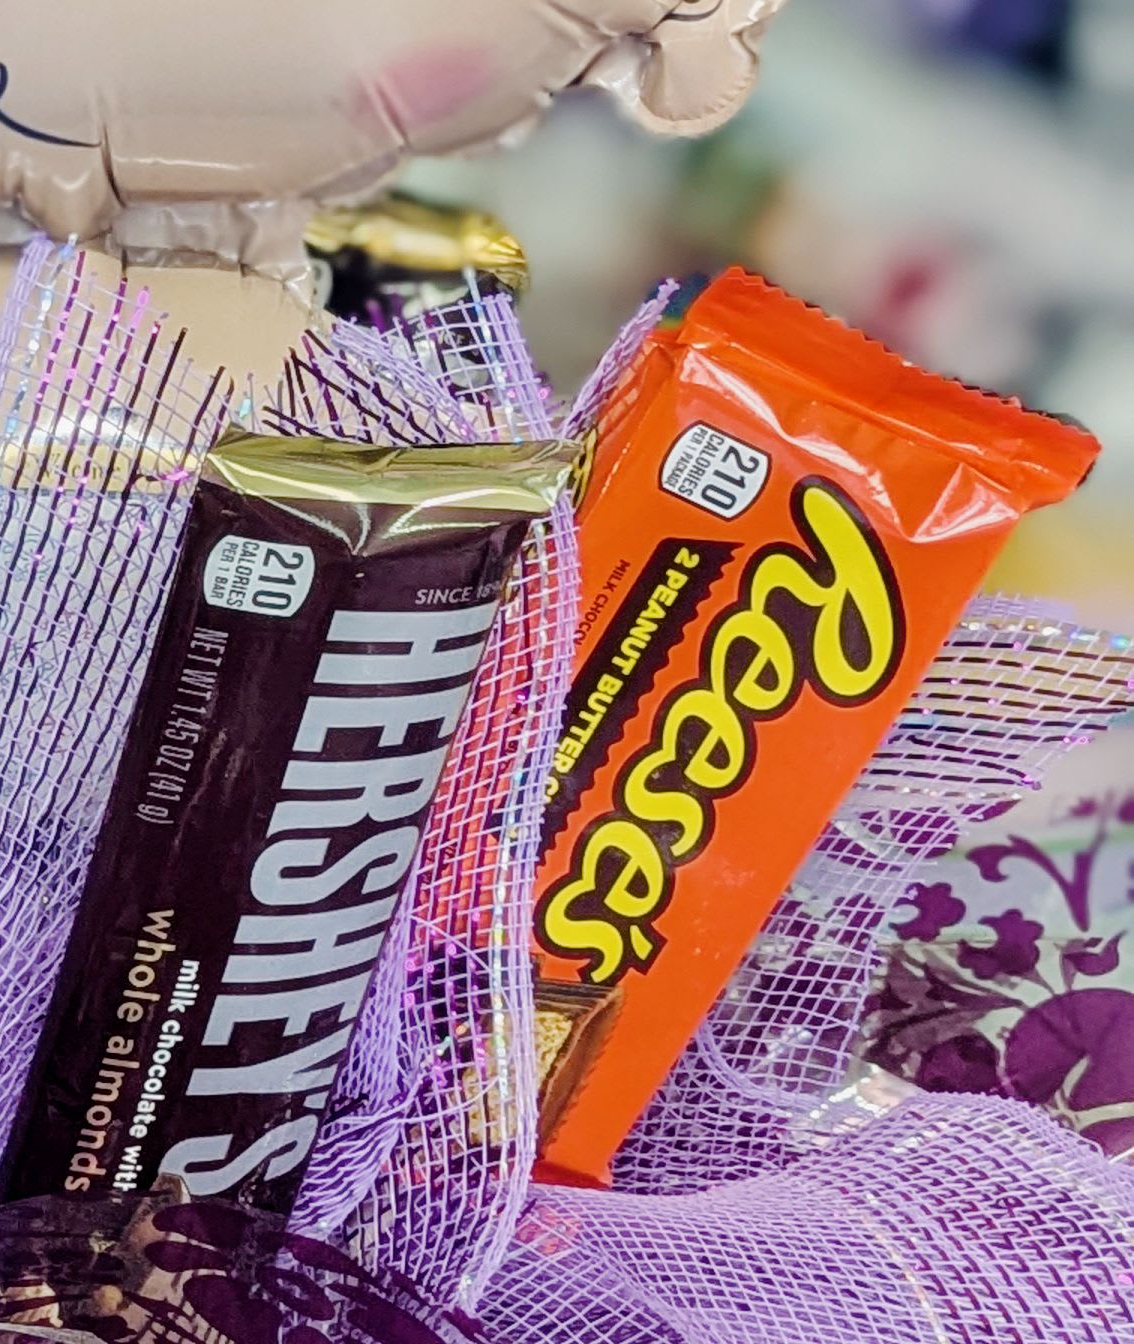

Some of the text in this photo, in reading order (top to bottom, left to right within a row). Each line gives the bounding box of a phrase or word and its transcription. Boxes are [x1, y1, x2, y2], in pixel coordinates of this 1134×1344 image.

[665, 427, 708, 488] PER 1 PACKAGE
[677, 433, 725, 497] CALORIES
[701, 445, 760, 510] 210
[220, 542, 239, 563] PER
[227, 541, 260, 607] CALORIES
[251, 548, 304, 610] 210
[602, 558, 631, 592] MILK
[210, 576, 228, 599] BAR
[414, 586, 473, 605] SINCE
[552, 547, 700, 774] 2 PEANUT BUTTER
[135, 626, 229, 825] NET WT 1.45 OZ (41 g)
[544, 486, 894, 983] Reese's
[159, 608, 499, 1196] HERSHEY'S
[168, 959, 200, 1014] milk
[64, 909, 177, 1192] whole almonds
[129, 1019, 184, 1139] chocolate
